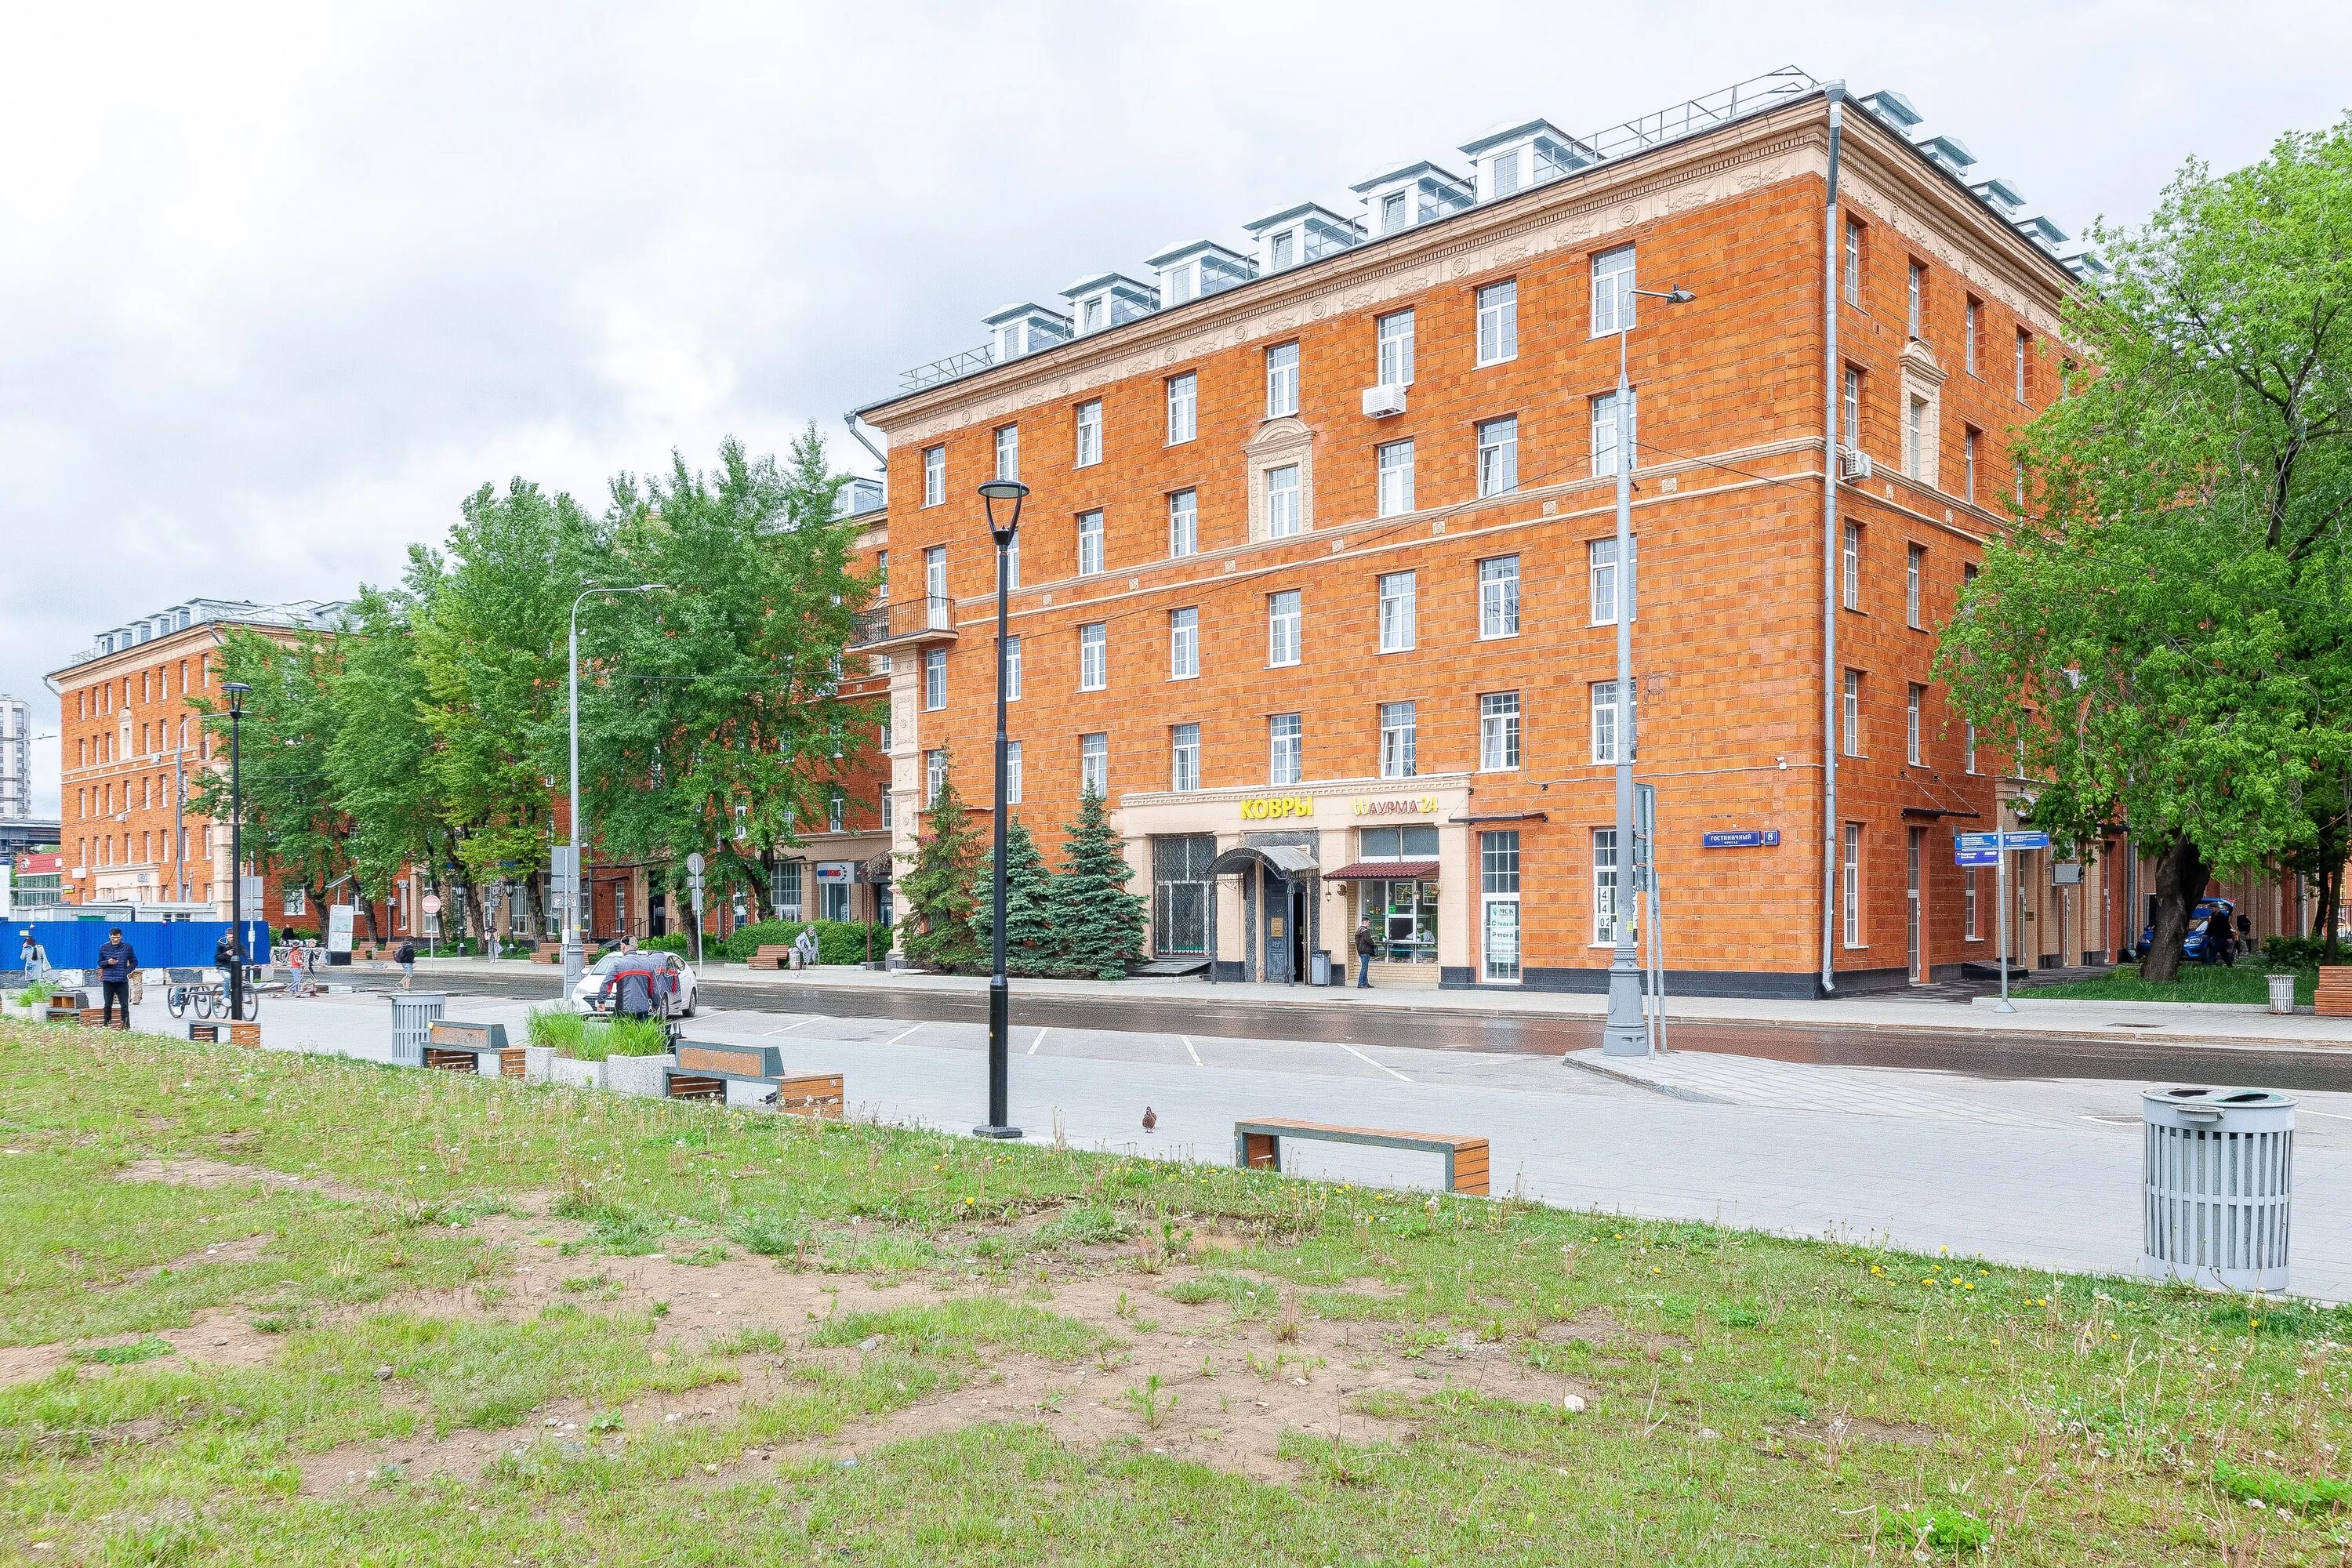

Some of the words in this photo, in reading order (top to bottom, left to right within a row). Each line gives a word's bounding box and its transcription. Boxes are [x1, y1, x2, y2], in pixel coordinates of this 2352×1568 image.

[1241, 796, 1314, 819] КОВРЫ
[1420, 796, 1439, 813] 24
[1767, 832, 1773, 841] 8
[1602, 890, 1607, 899] 4
[1602, 904, 1607, 913] 4
